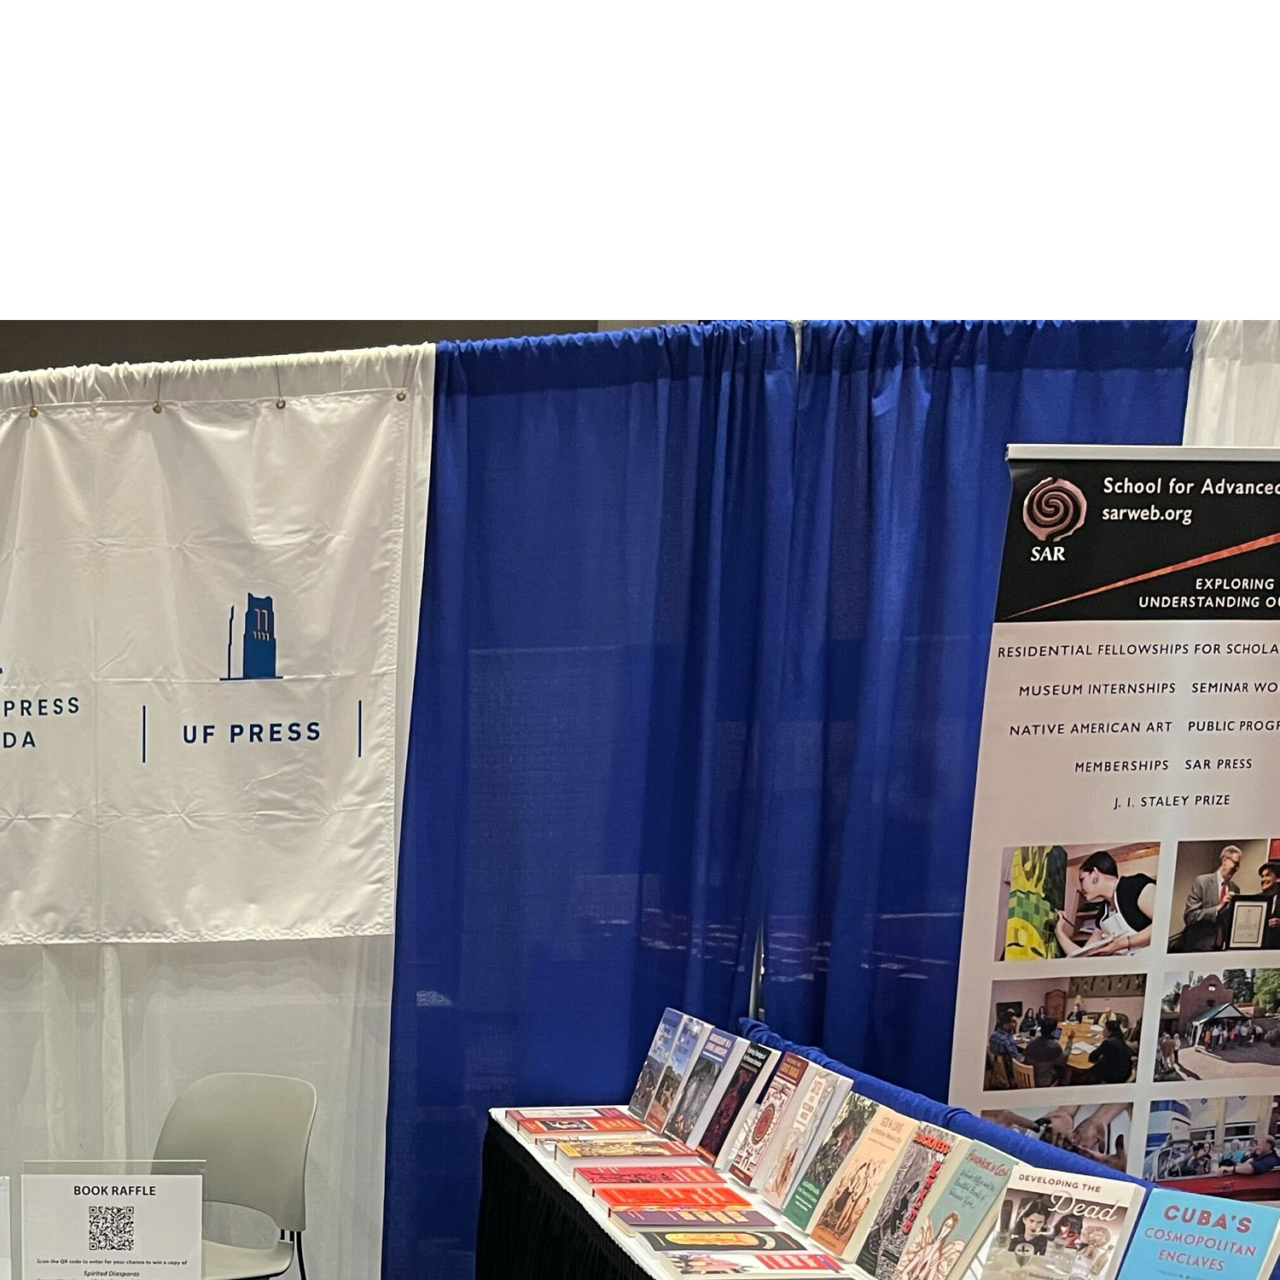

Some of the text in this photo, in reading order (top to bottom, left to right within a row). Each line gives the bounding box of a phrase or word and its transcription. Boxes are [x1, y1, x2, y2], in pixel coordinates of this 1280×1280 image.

[1103, 477, 1162, 494] School
[1169, 478, 1194, 494] for
[1101, 505, 1193, 525] sarweb.org
[1030, 546, 1066, 562] SAR
[1195, 578, 1275, 590] EXPLORING
[1138, 596, 1261, 608] UNDERSTANDING
[997, 645, 1093, 658] RESIDENTIAL
[1097, 644, 1189, 656] FELLOWSHIPS
[1194, 643, 1221, 654] FOR
[1019, 684, 1083, 696] MUSEUM
[1088, 683, 1176, 694] INTERNSHIPS
[1191, 682, 1249, 693] SEMINAR
[3, 696, 80, 717] PRESS
[183, 721, 322, 745] UF PRESS
[1009, 723, 1065, 736] NATIVE
[1070, 722, 1141, 734] AMERICAN
[1146, 721, 1173, 733] ART
[1187, 720, 1235, 732] PUBLIC
[1074, 758, 1252, 772] MEMBERSHIPS SAR PRESS
[1113, 794, 1230, 810] J. I. STALEY PRIZE
[73, 1185, 156, 1196] BOOK RAFFLE
[1018, 1174, 1102, 1193] DEVELOPING THE
[1047, 1190, 1120, 1221] Dead
[1163, 1204, 1252, 1234] CUBA'S
[1144, 1227, 1257, 1257] COSMOPOLITAN
[1157, 1249, 1225, 1272] ENCLAVES
[83, 1270, 140, 1278] Spirited Diasporas
